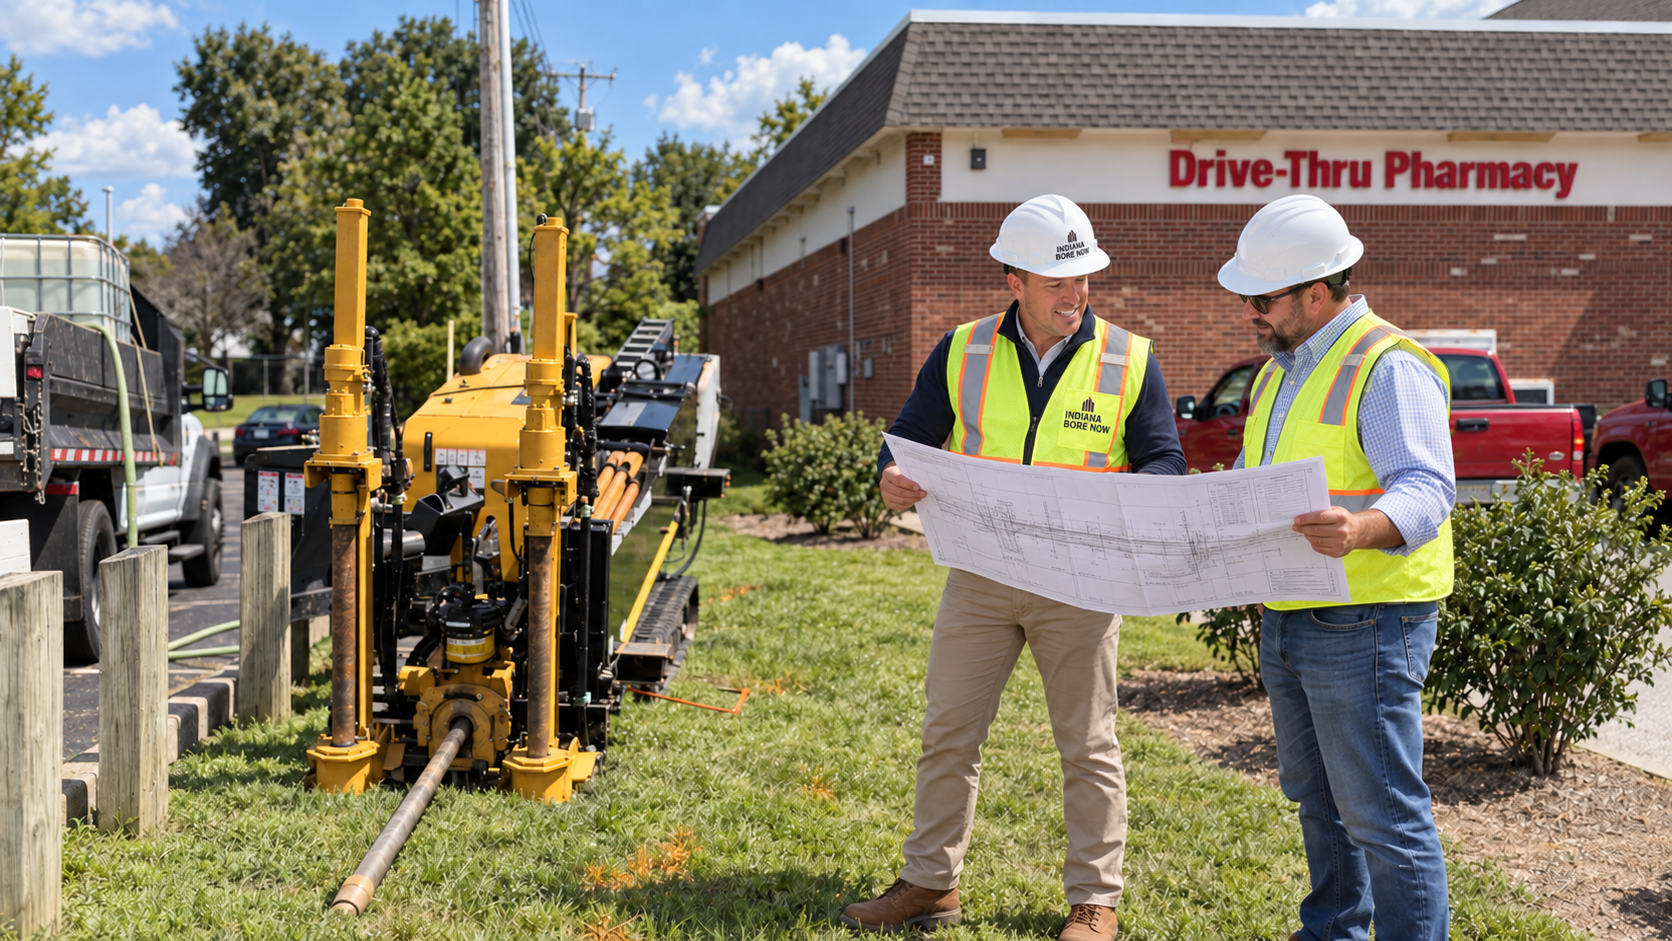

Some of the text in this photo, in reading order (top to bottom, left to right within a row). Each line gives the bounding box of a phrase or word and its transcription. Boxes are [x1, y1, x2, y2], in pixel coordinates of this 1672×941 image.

[1169, 149, 1579, 199] Drive-Thru Pharmacy
[1056, 241, 1085, 252] INDIANA
[1056, 247, 1089, 260] BORE NOW
[1065, 411, 1101, 423] INDIANA
[1064, 420, 1110, 434] BORE NOW
